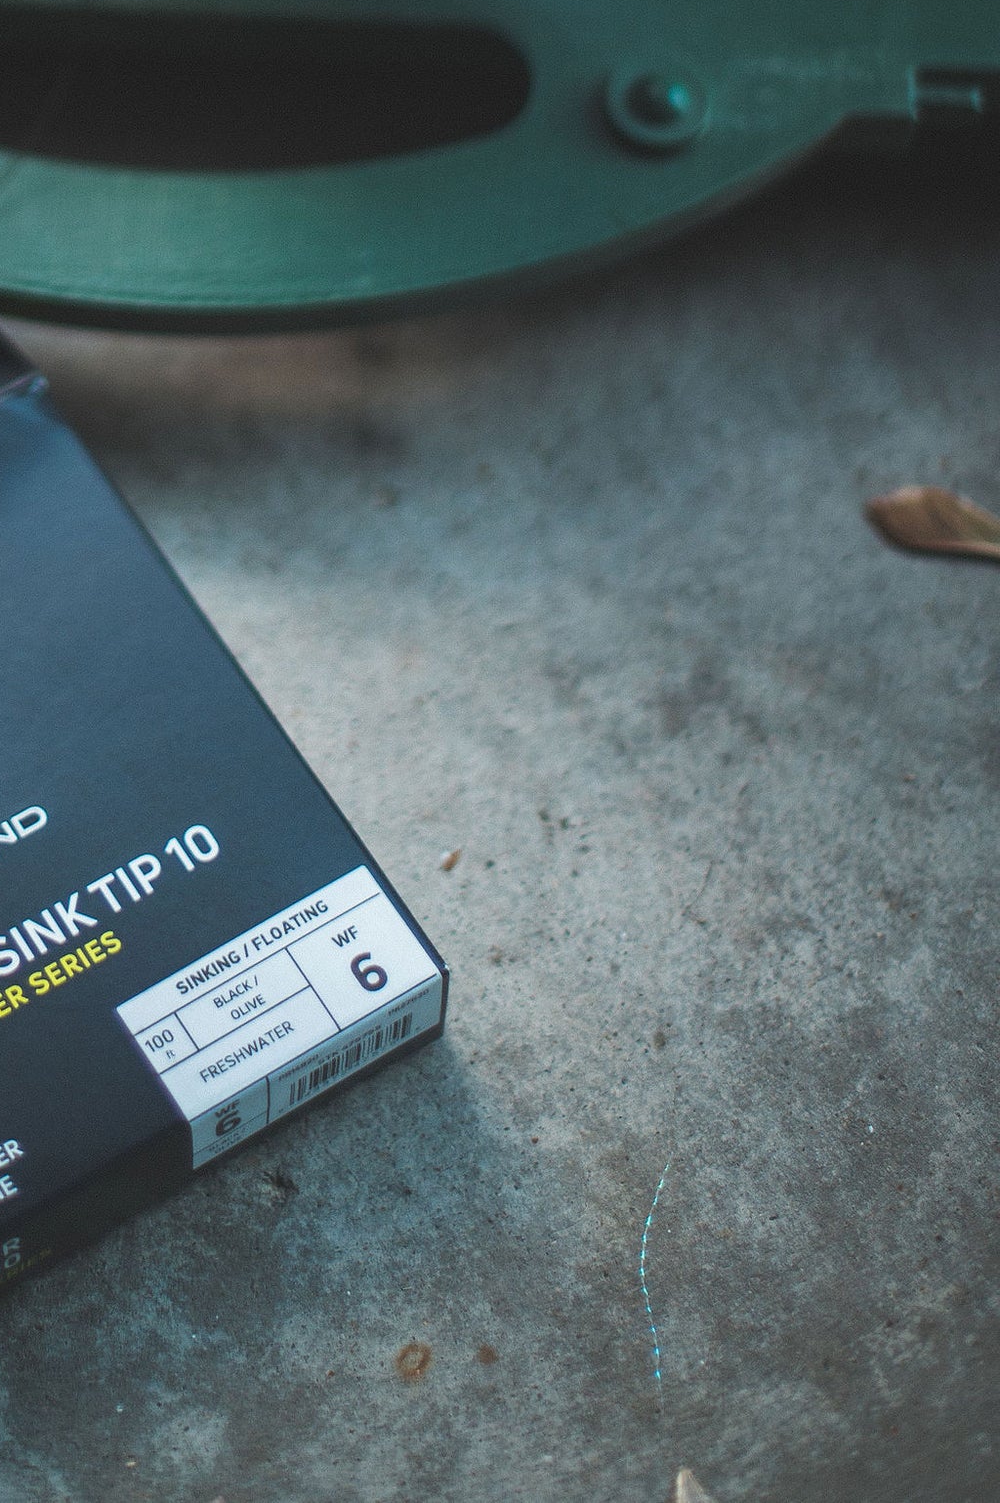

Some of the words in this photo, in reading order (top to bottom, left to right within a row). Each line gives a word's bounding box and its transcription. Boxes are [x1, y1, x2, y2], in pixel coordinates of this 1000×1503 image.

[88, 852, 162, 914] TIP
[164, 823, 220, 872] 10
[175, 948, 242, 995] SINKING
[251, 899, 329, 952] FLOATING
[331, 925, 360, 949] WF
[28, 930, 123, 996] SERIES
[350, 951, 388, 992] 6
[212, 979, 254, 1009] BLACK
[230, 994, 266, 1021] OLIVE
[144, 1028, 175, 1054] 100
[166, 1048, 175, 1060] ft
[199, 1020, 295, 1083] FRESHWATER
[214, 1098, 240, 1118] WF
[215, 1109, 242, 1137] 6
